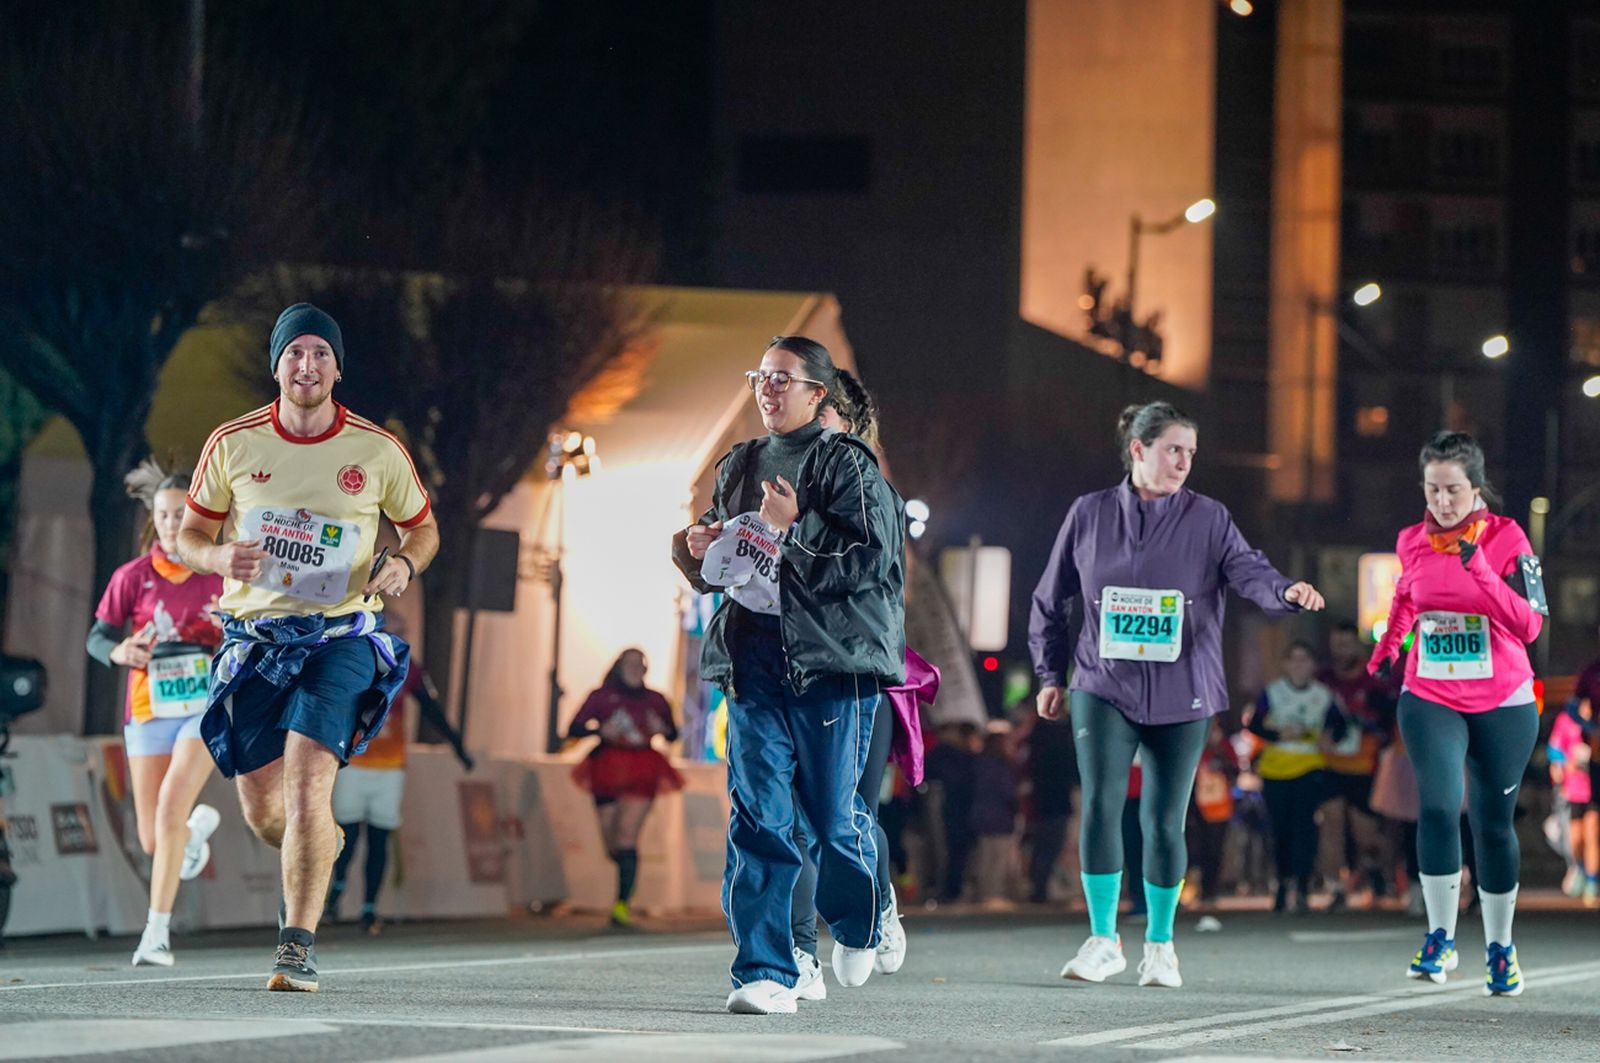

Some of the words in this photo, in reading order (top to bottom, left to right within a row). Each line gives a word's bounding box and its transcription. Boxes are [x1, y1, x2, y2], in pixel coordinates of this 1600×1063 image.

[260, 524, 280, 535] SAN
[274, 517, 301, 529] NOCHE
[303, 523, 315, 532] DE
[736, 528, 753, 540] SAN
[263, 535, 325, 567] 80085
[280, 561, 300, 572] Manu
[1112, 613, 1173, 636] 12294
[1423, 633, 1480, 655] 13306
